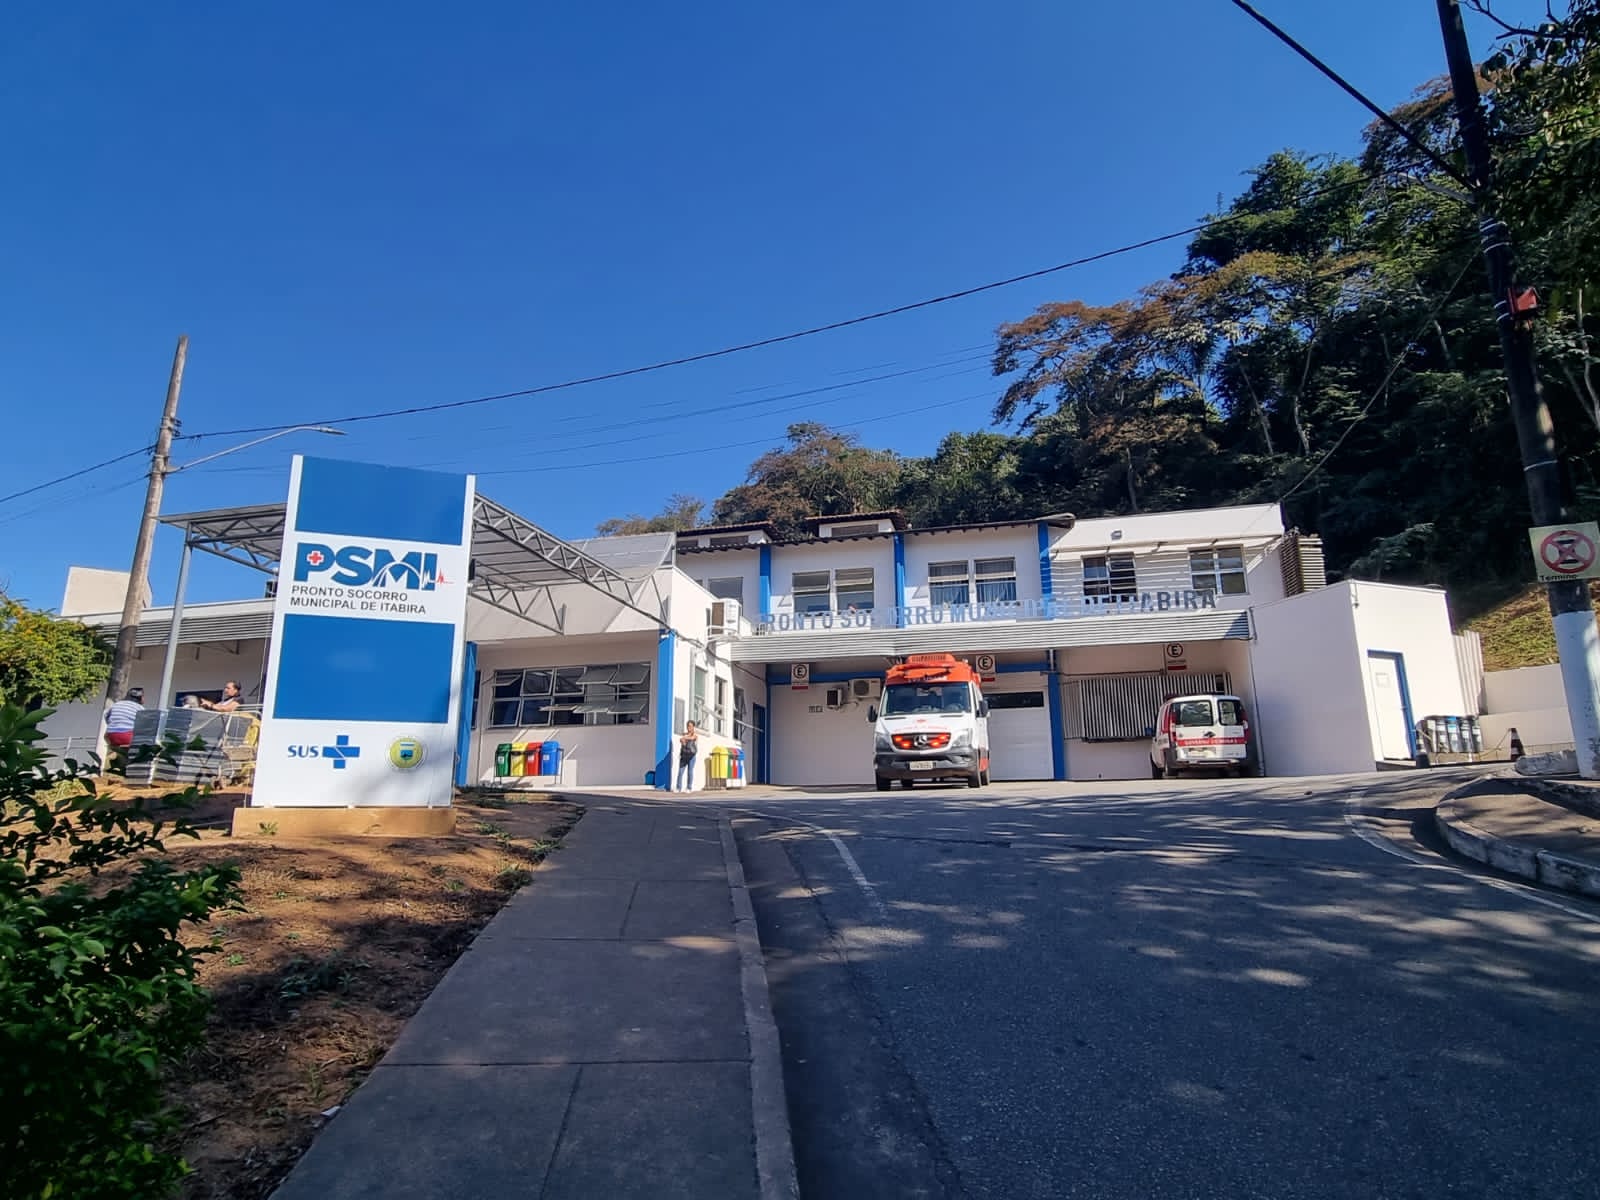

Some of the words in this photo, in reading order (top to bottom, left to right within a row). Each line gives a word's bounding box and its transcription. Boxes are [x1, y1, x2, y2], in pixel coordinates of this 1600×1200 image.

[294, 542, 438, 591] PSMI
[291, 585, 344, 598] PRONTO
[347, 589, 408, 602] SOCORRO
[290, 596, 357, 610] MUNICIPAL
[360, 601, 377, 611] DE
[380, 603, 426, 614] ITABIRA
[750, 610, 833, 632] RONTO
[840, 604, 943, 628] SORRO
[287, 745, 319, 758] SUS
